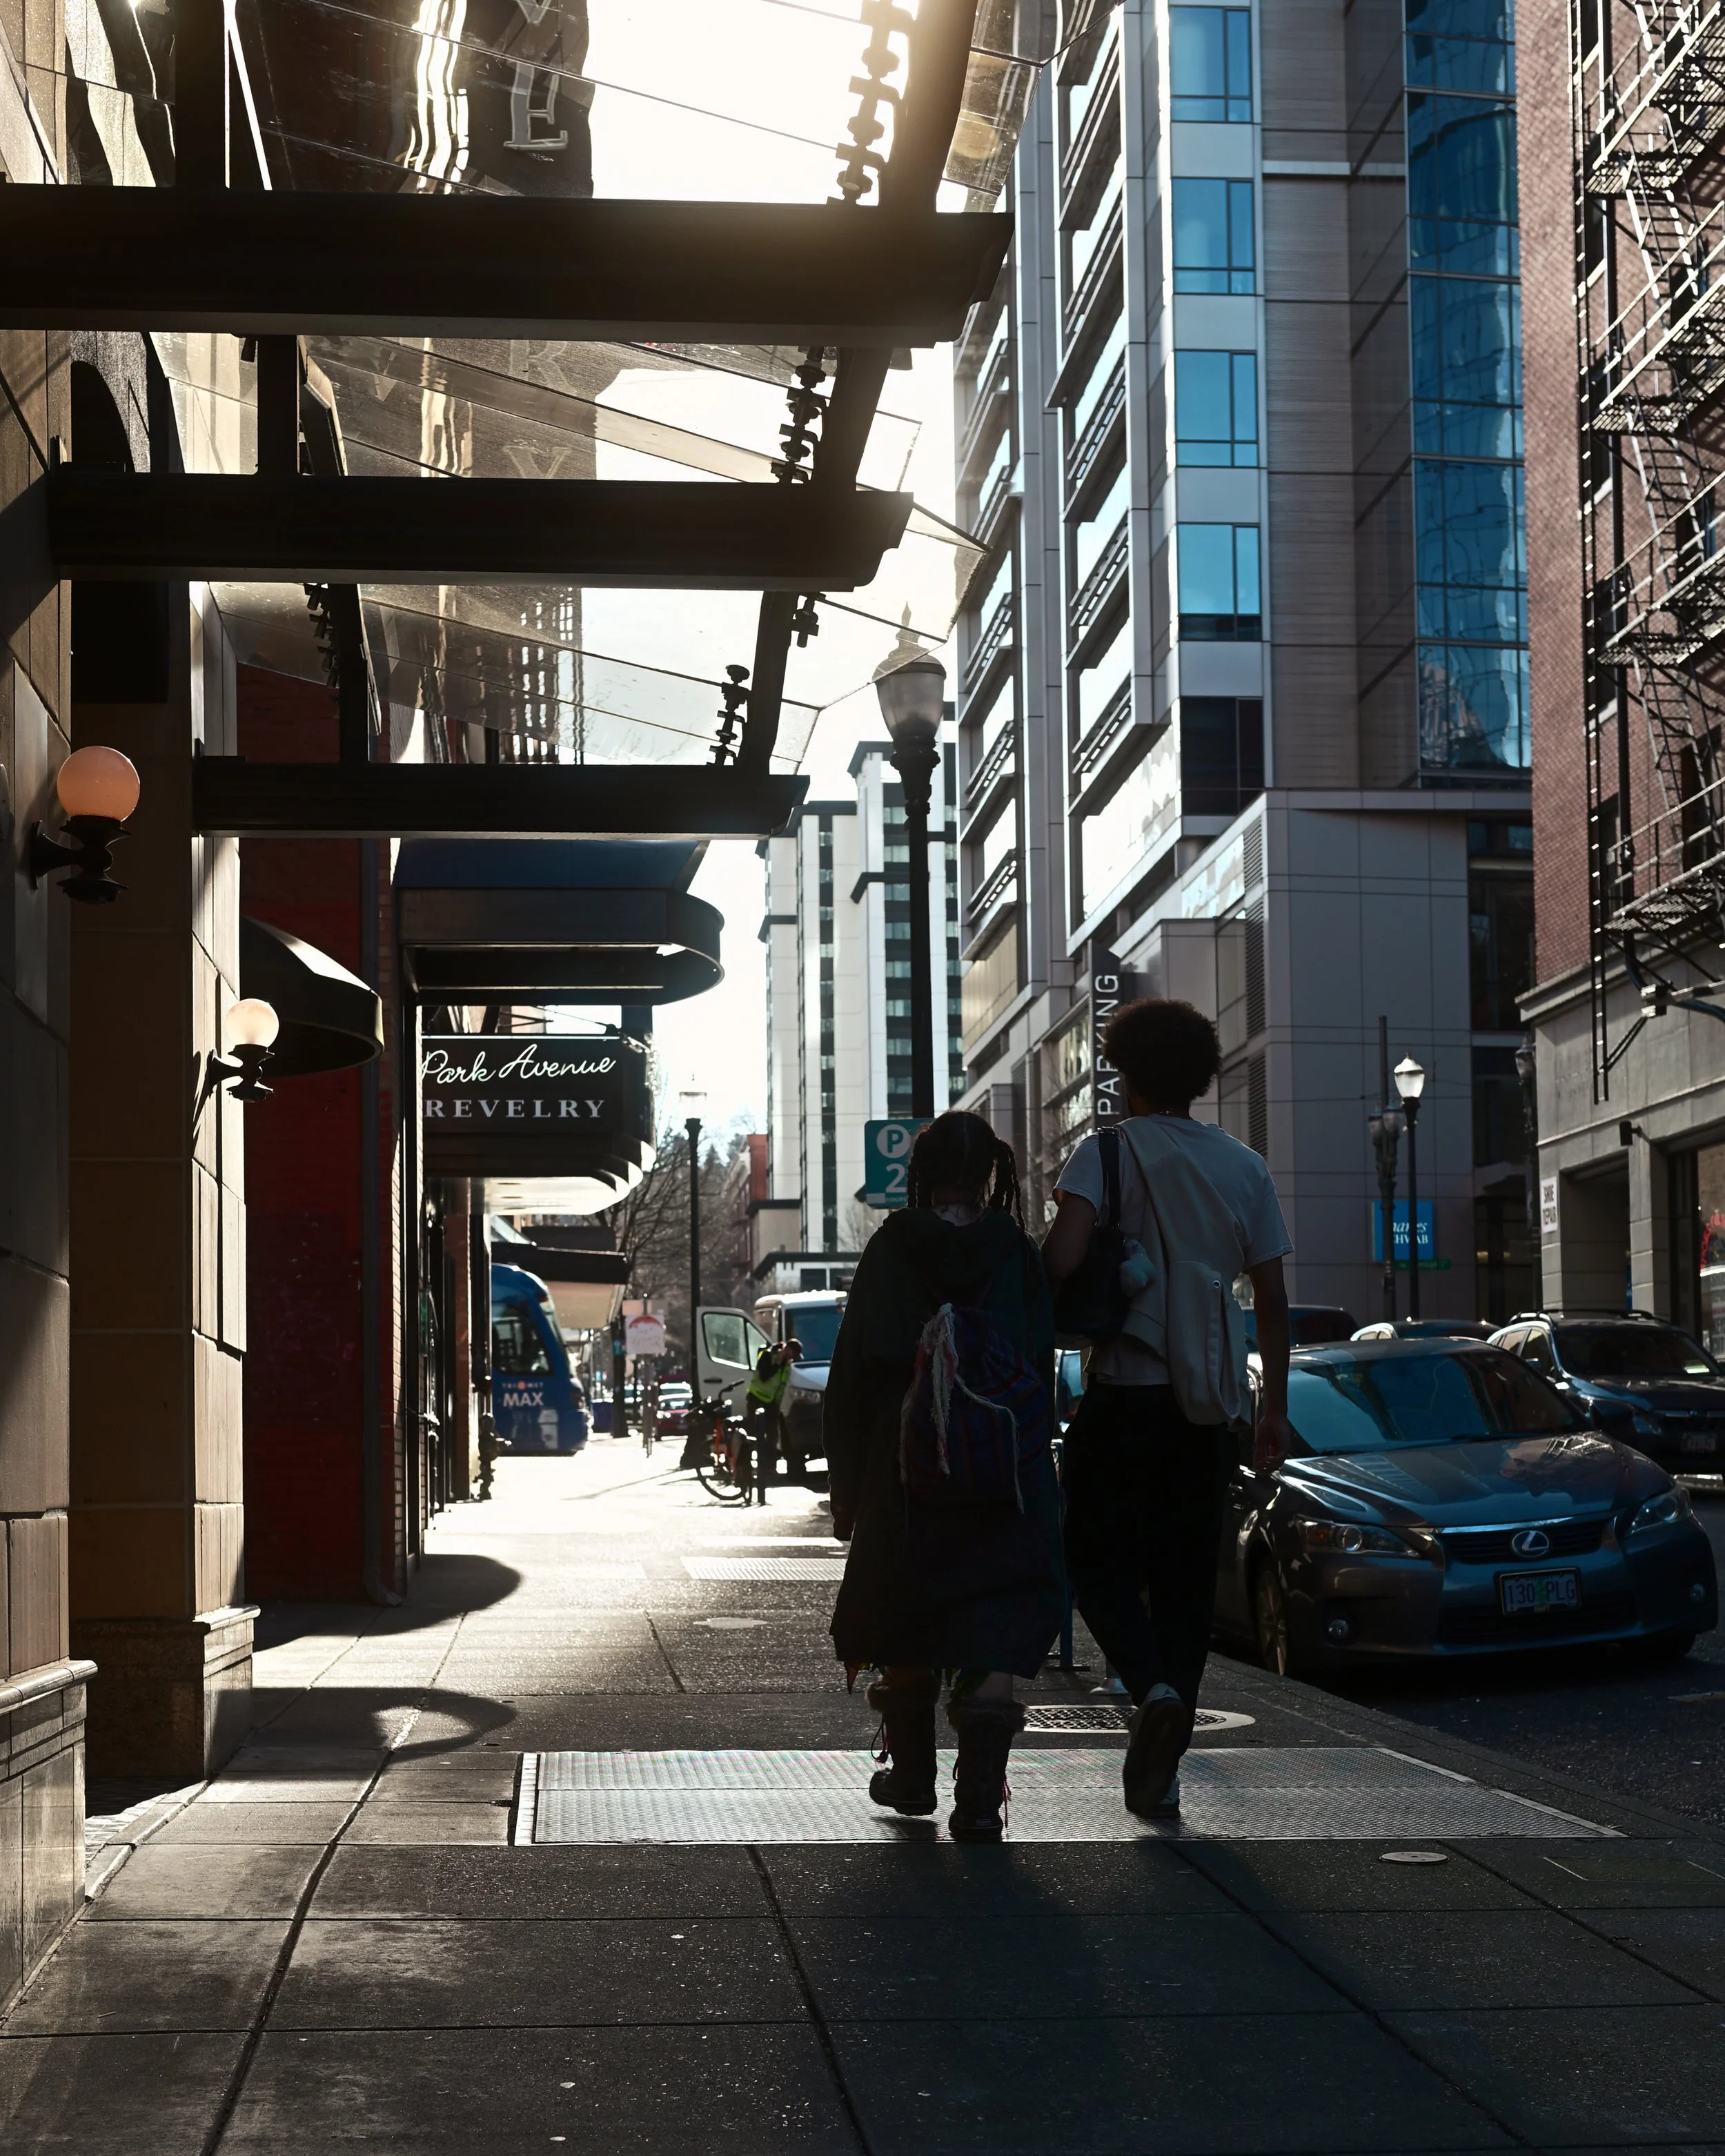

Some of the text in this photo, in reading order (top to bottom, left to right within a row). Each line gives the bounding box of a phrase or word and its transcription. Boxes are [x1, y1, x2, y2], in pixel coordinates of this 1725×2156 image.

[422, 1042, 617, 1084] Park Avenue
[423, 1098, 605, 1118] REVELRY
[887, 1129, 903, 1154] P
[885, 1162, 907, 1194] 2
[503, 1391, 544, 1407] MAX
[1508, 1579, 1575, 1605] 130 PLG
